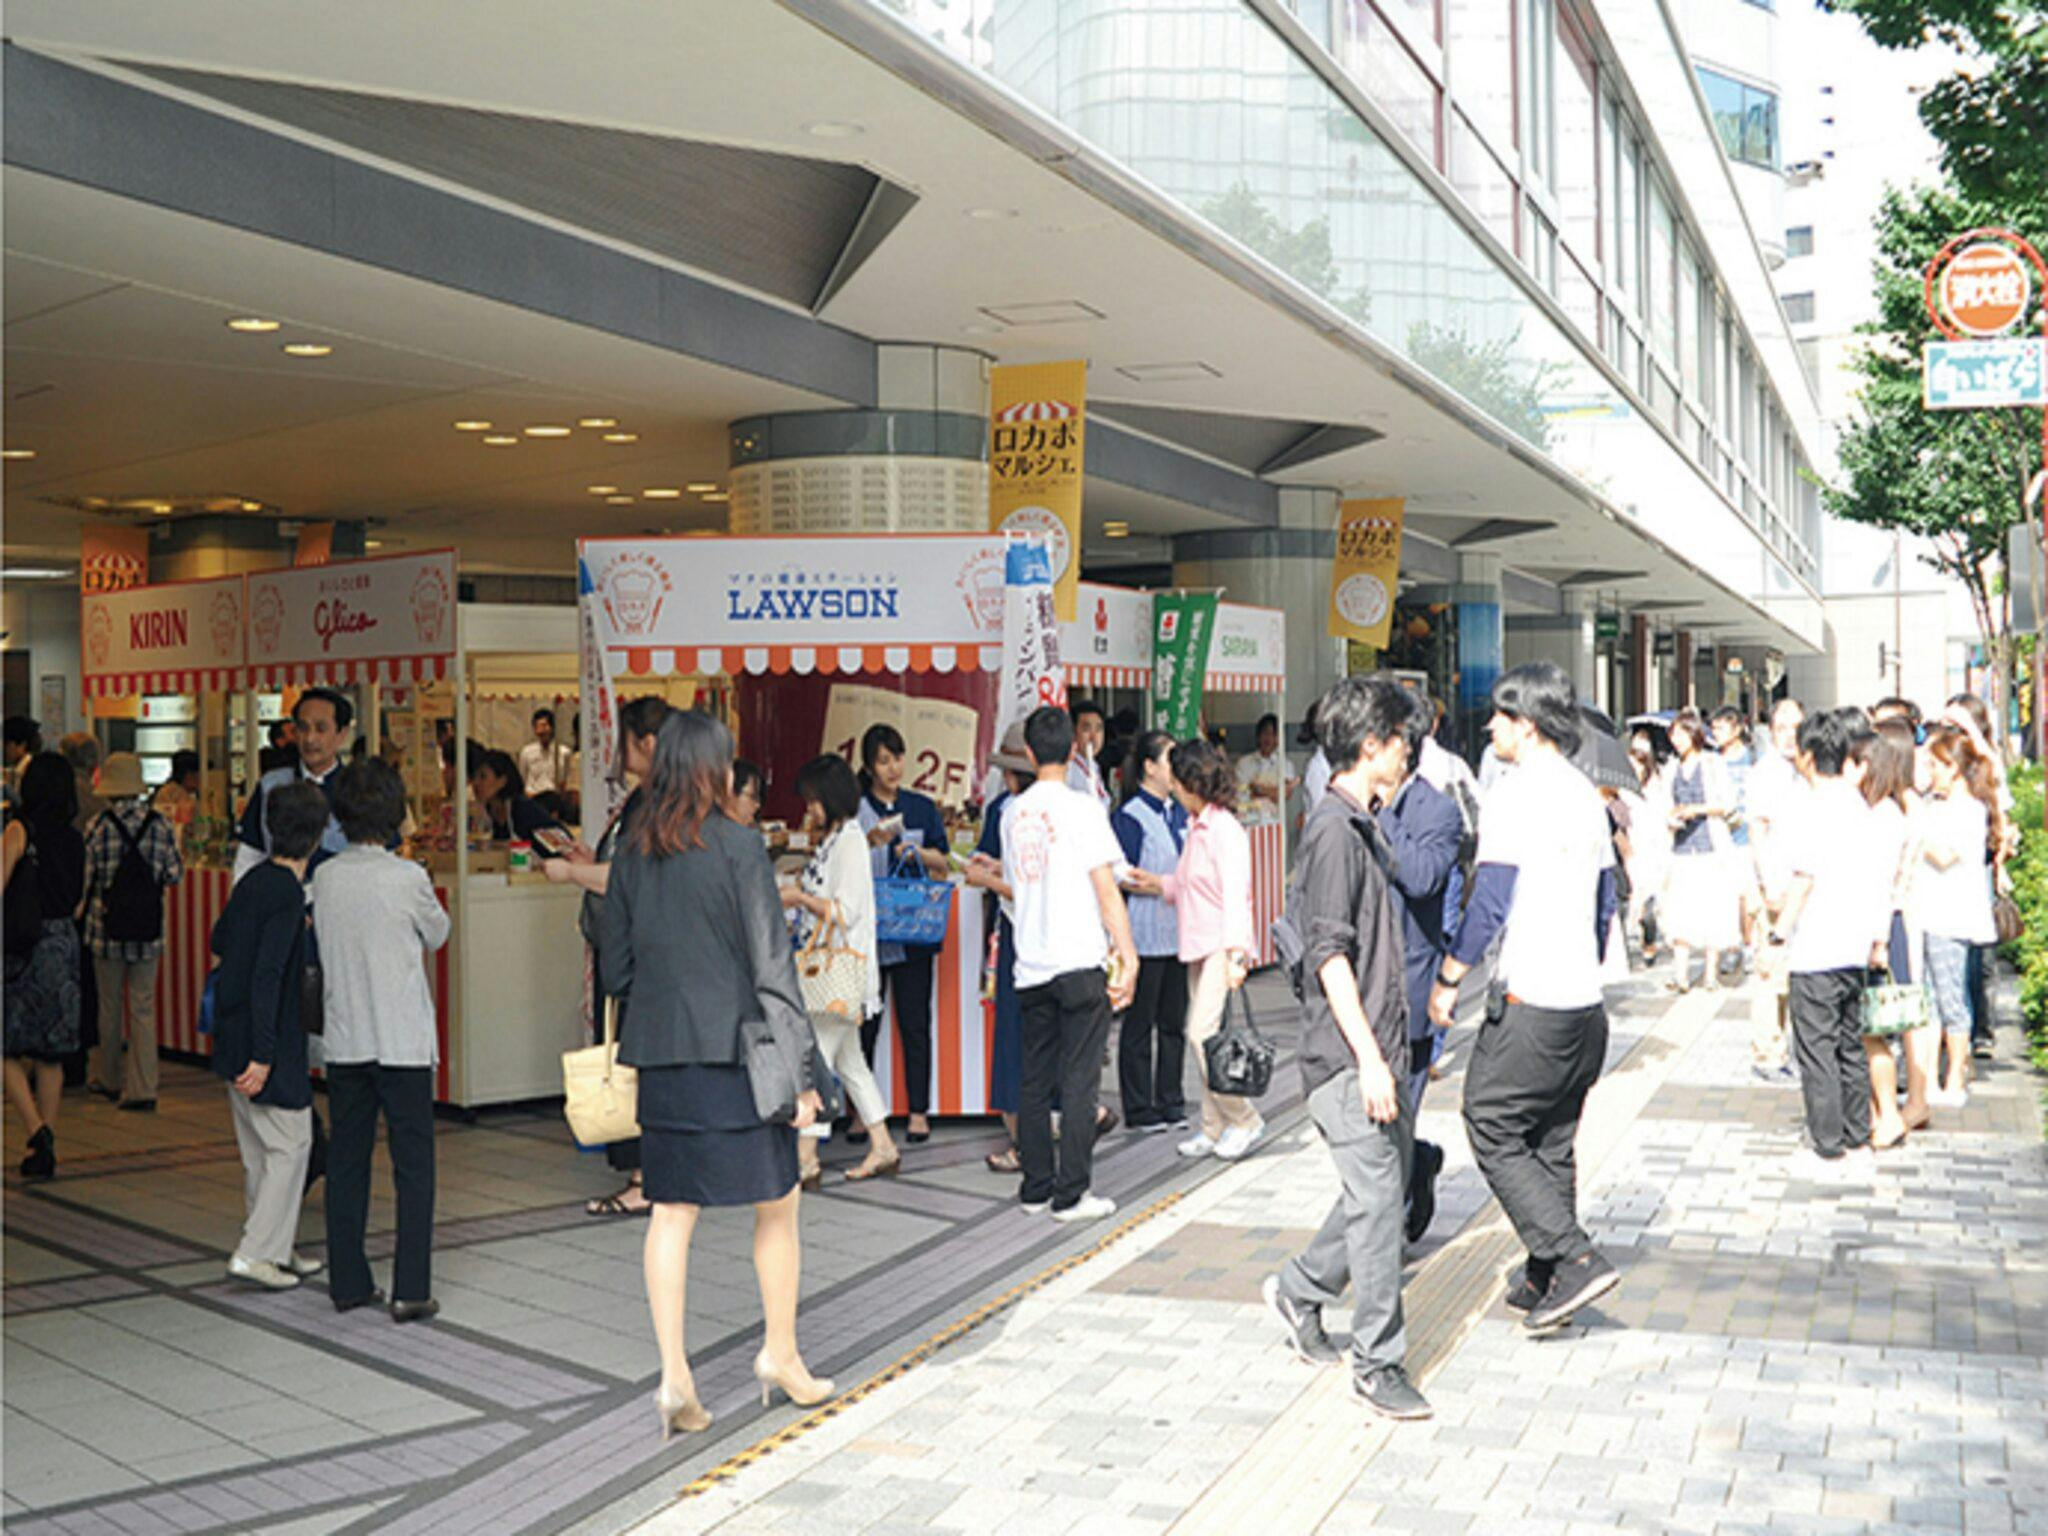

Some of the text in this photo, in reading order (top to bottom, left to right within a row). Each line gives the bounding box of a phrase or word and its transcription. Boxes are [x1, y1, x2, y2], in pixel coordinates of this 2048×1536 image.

[1951, 271, 2021, 308] 消火栓
[993, 420, 1077, 453] ロカボ
[993, 453, 1076, 479] マルシェ
[728, 589, 899, 621] LAWSON
[130, 608, 188, 650] KIRIN
[314, 598, 378, 652] Glico
[911, 749, 967, 796] 2F
